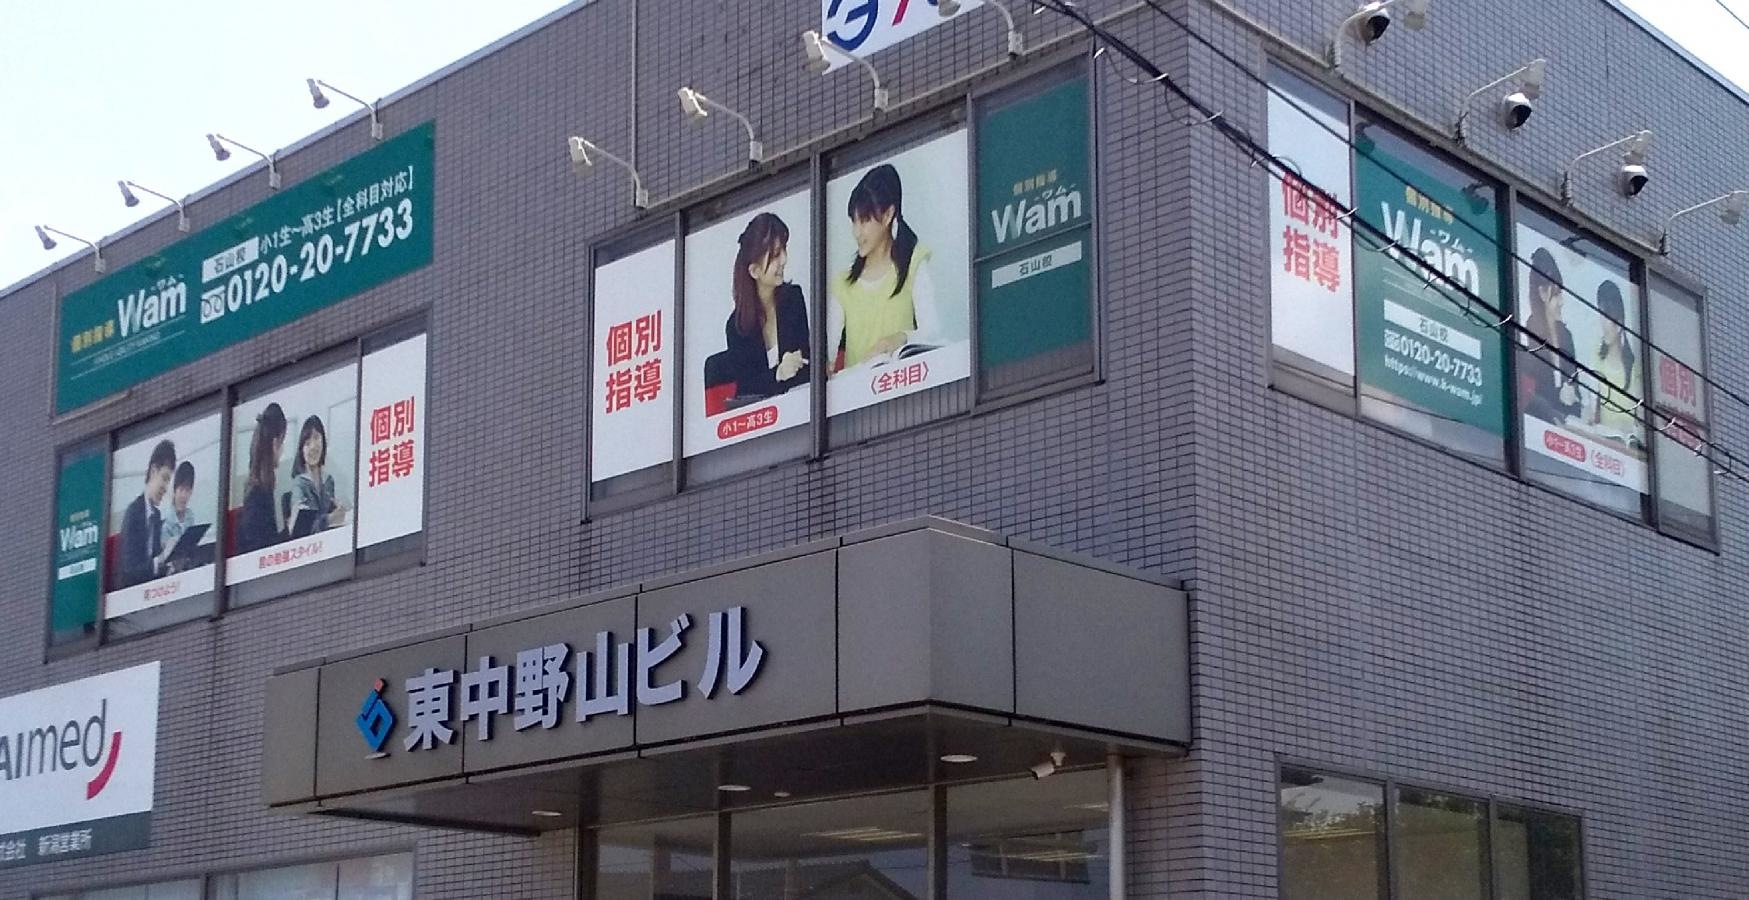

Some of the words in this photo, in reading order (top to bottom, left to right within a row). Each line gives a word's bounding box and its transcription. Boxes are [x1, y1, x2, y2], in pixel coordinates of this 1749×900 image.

[991, 190, 1082, 244] Wam
[226, 197, 414, 313] 0120-20-7733
[1282, 225, 1341, 293] 指導
[1380, 200, 1480, 298] Wam
[117, 282, 187, 338] Wam
[605, 309, 663, 368] 個別
[605, 357, 663, 415] 指導
[1400, 334, 1484, 388] 0120-20-7733
[369, 395, 416, 446] 個別
[368, 439, 416, 488] 指導
[60, 524, 99, 553] Wam
[403, 605, 765, 752] 東中野山ビル
